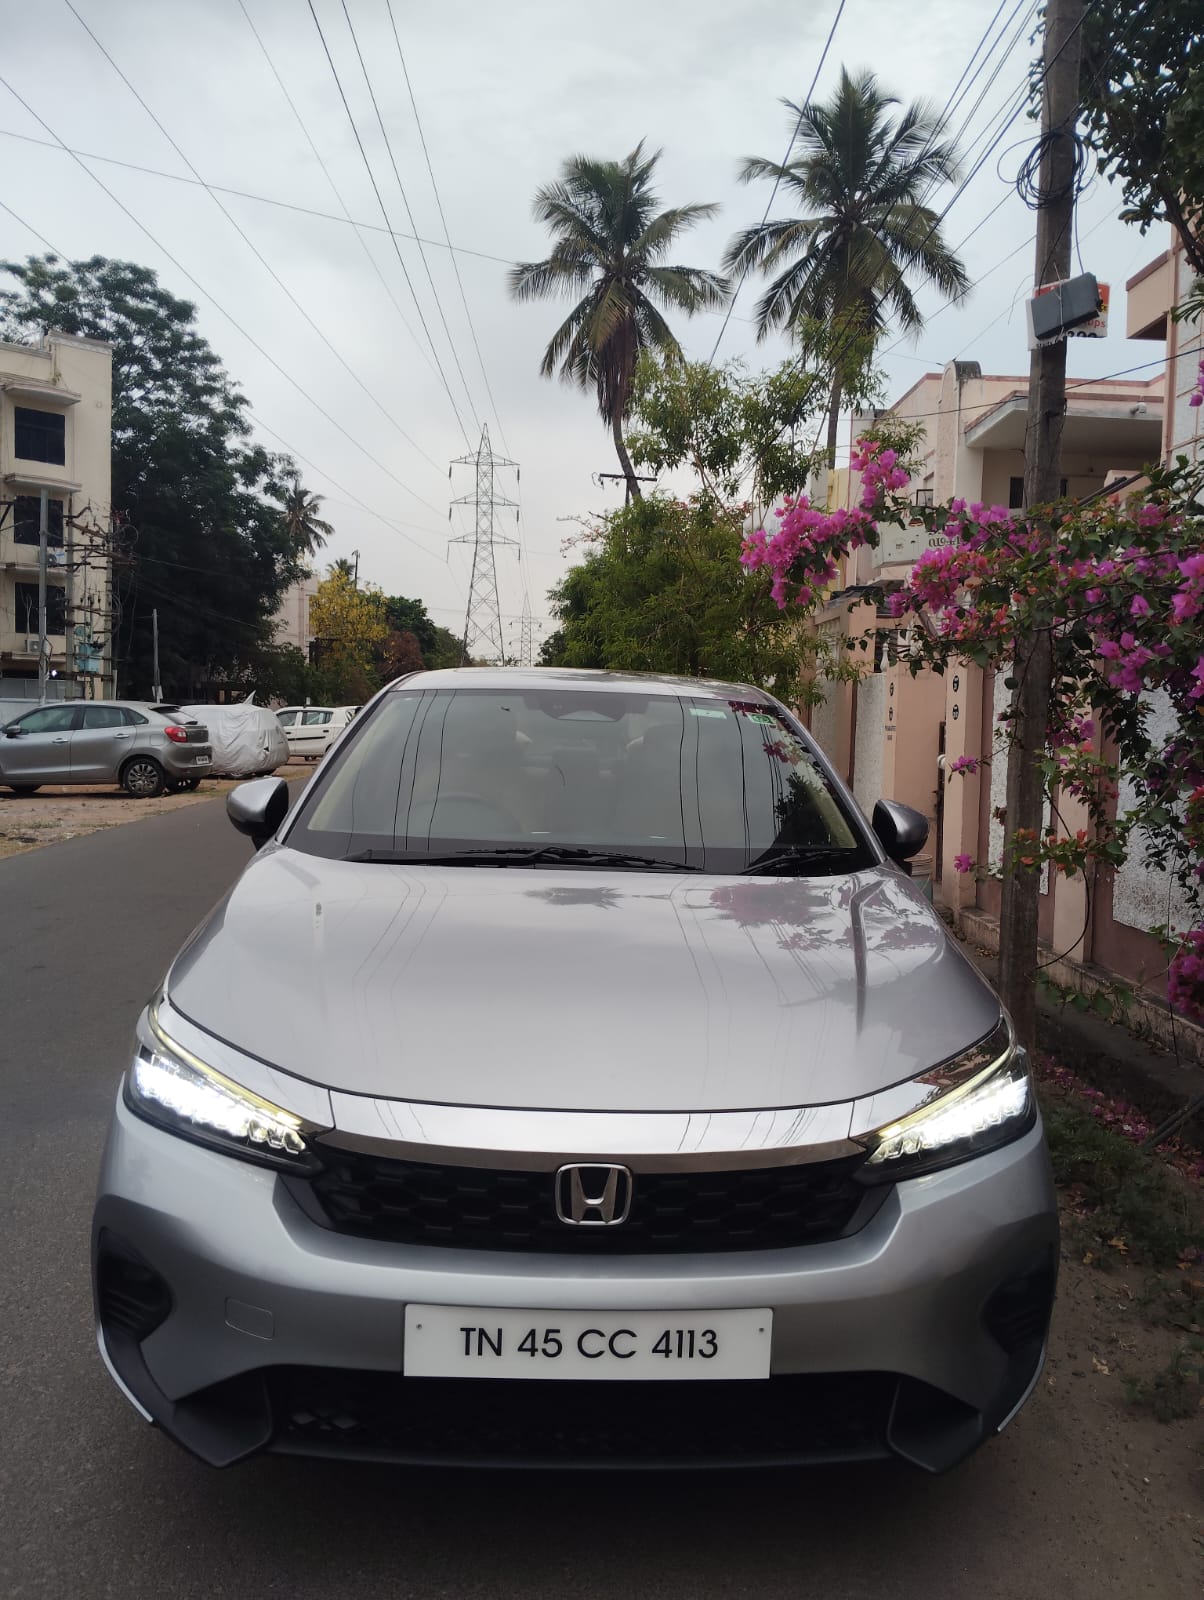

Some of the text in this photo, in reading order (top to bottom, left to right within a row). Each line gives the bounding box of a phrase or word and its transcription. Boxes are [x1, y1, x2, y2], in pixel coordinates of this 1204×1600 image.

[460, 1327, 719, 1359] TN 45 CC 4113
